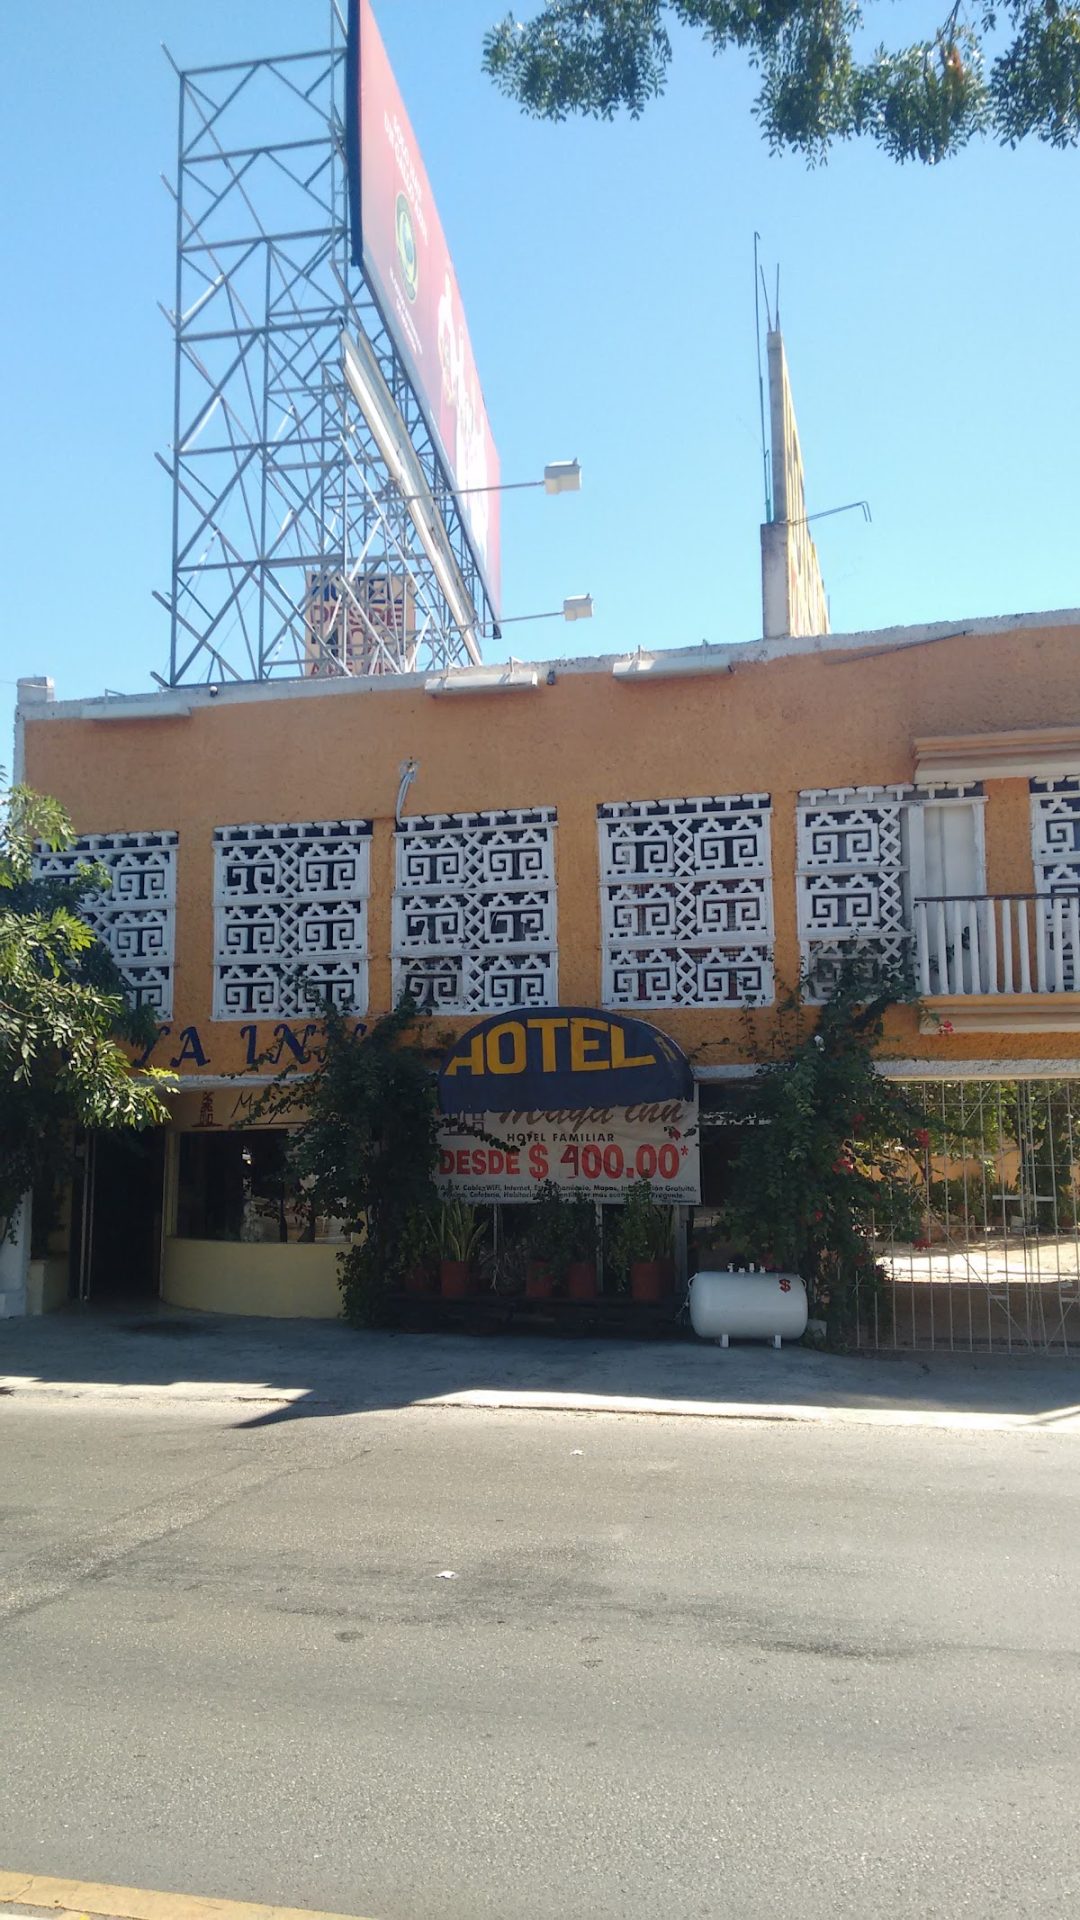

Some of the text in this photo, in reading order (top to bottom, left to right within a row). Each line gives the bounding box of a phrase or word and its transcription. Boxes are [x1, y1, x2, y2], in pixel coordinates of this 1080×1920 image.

[444, 1018, 656, 1076] HOTEL
[507, 1132, 615, 1143] HOTEL FAMILIAR
[438, 1148, 521, 1176] DESDE
